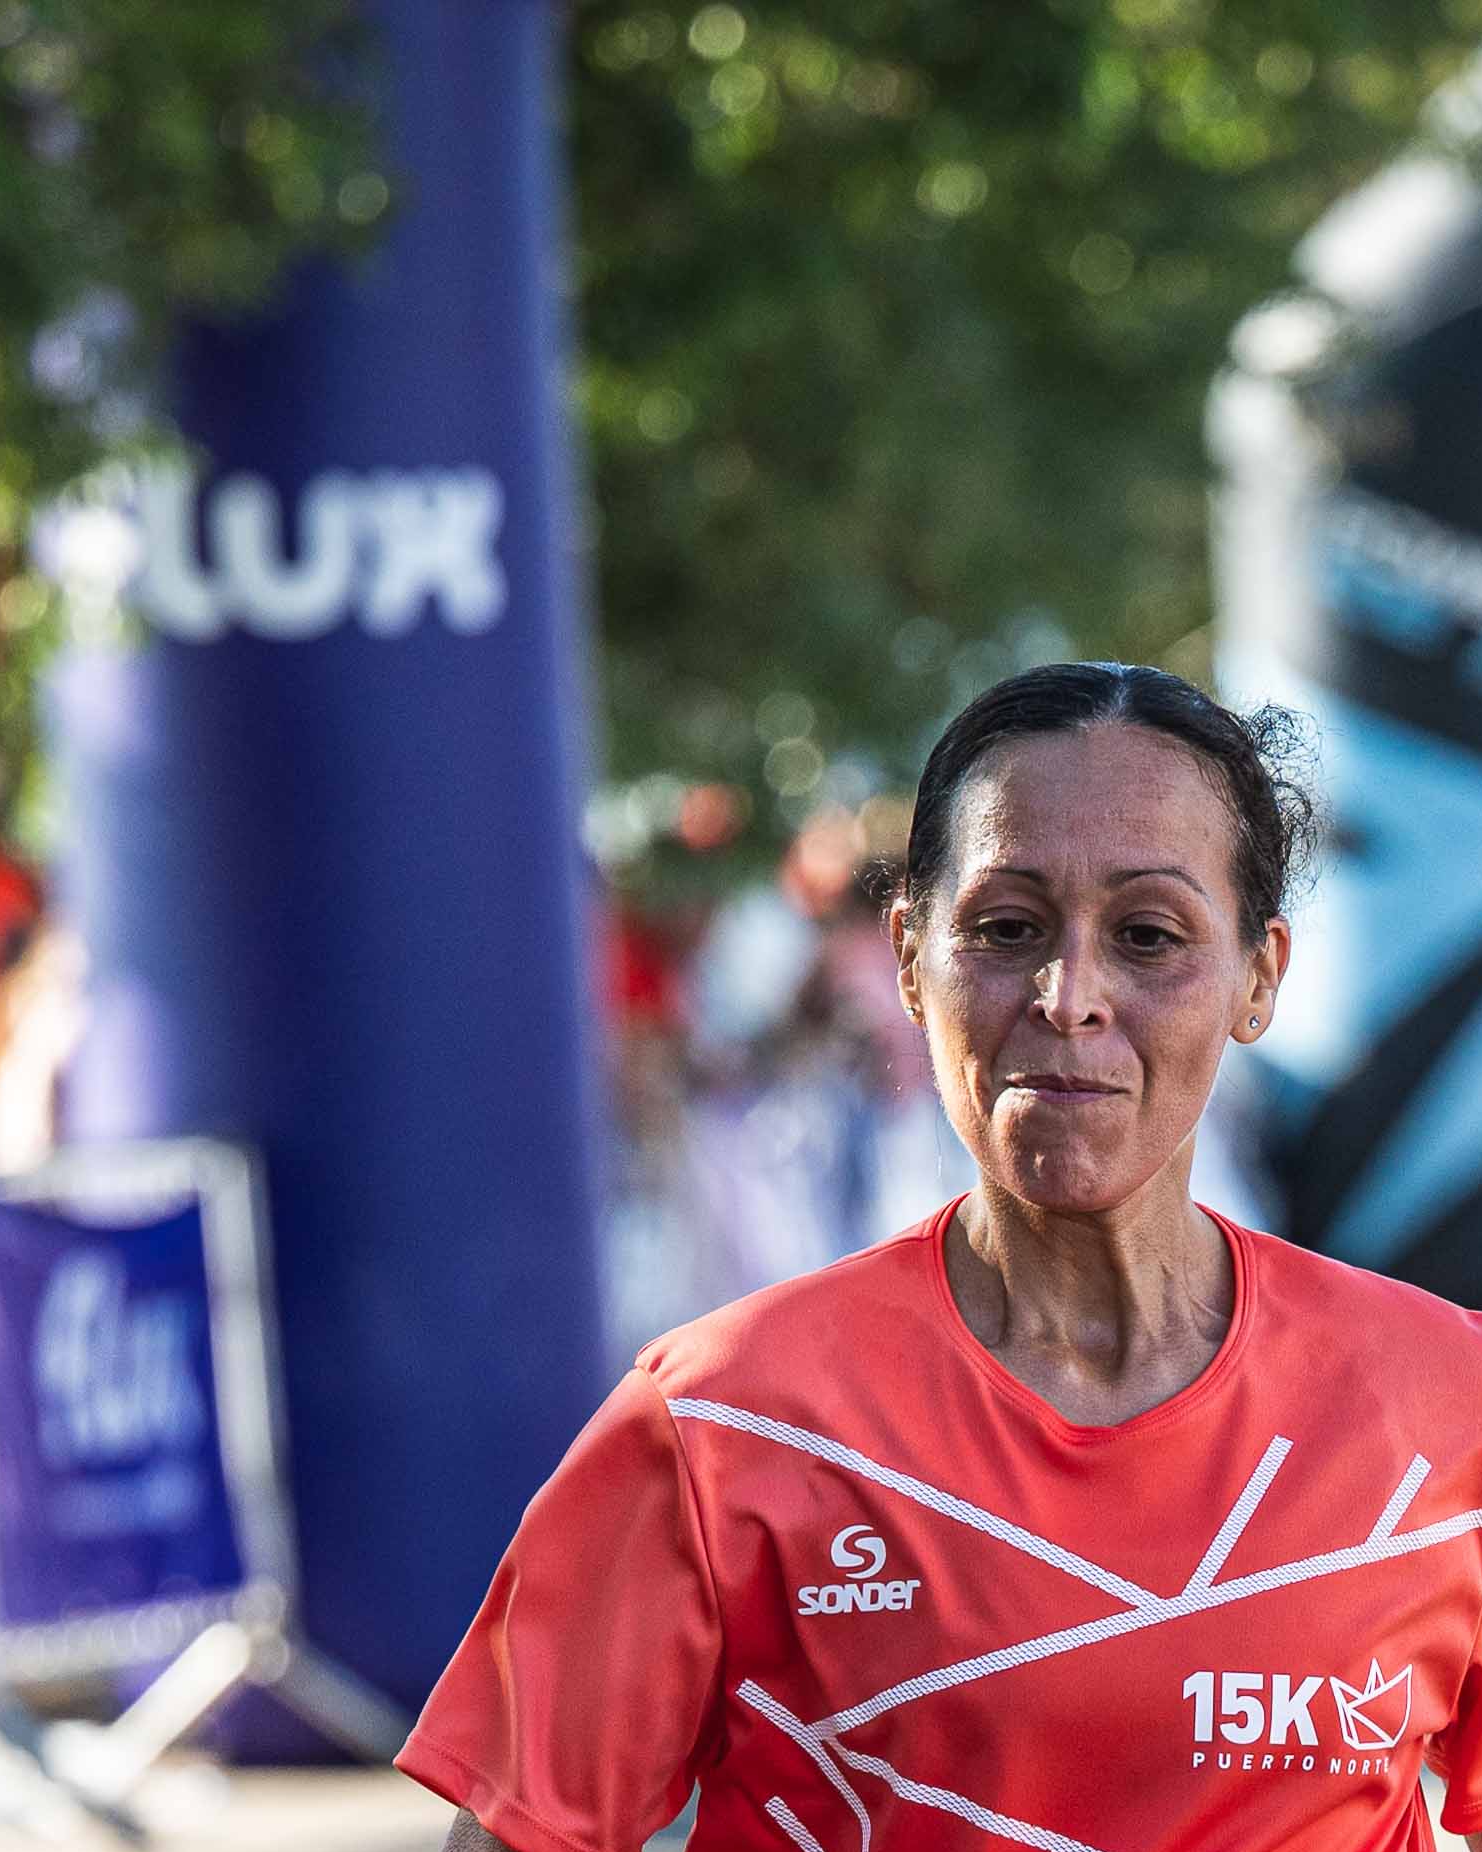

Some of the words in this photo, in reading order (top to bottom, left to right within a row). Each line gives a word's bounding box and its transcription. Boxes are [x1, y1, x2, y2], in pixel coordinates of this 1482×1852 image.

[88, 465, 508, 642] lux
[1182, 1671, 1326, 1746] 15K
[1192, 1752, 1316, 1772] PUERTO
